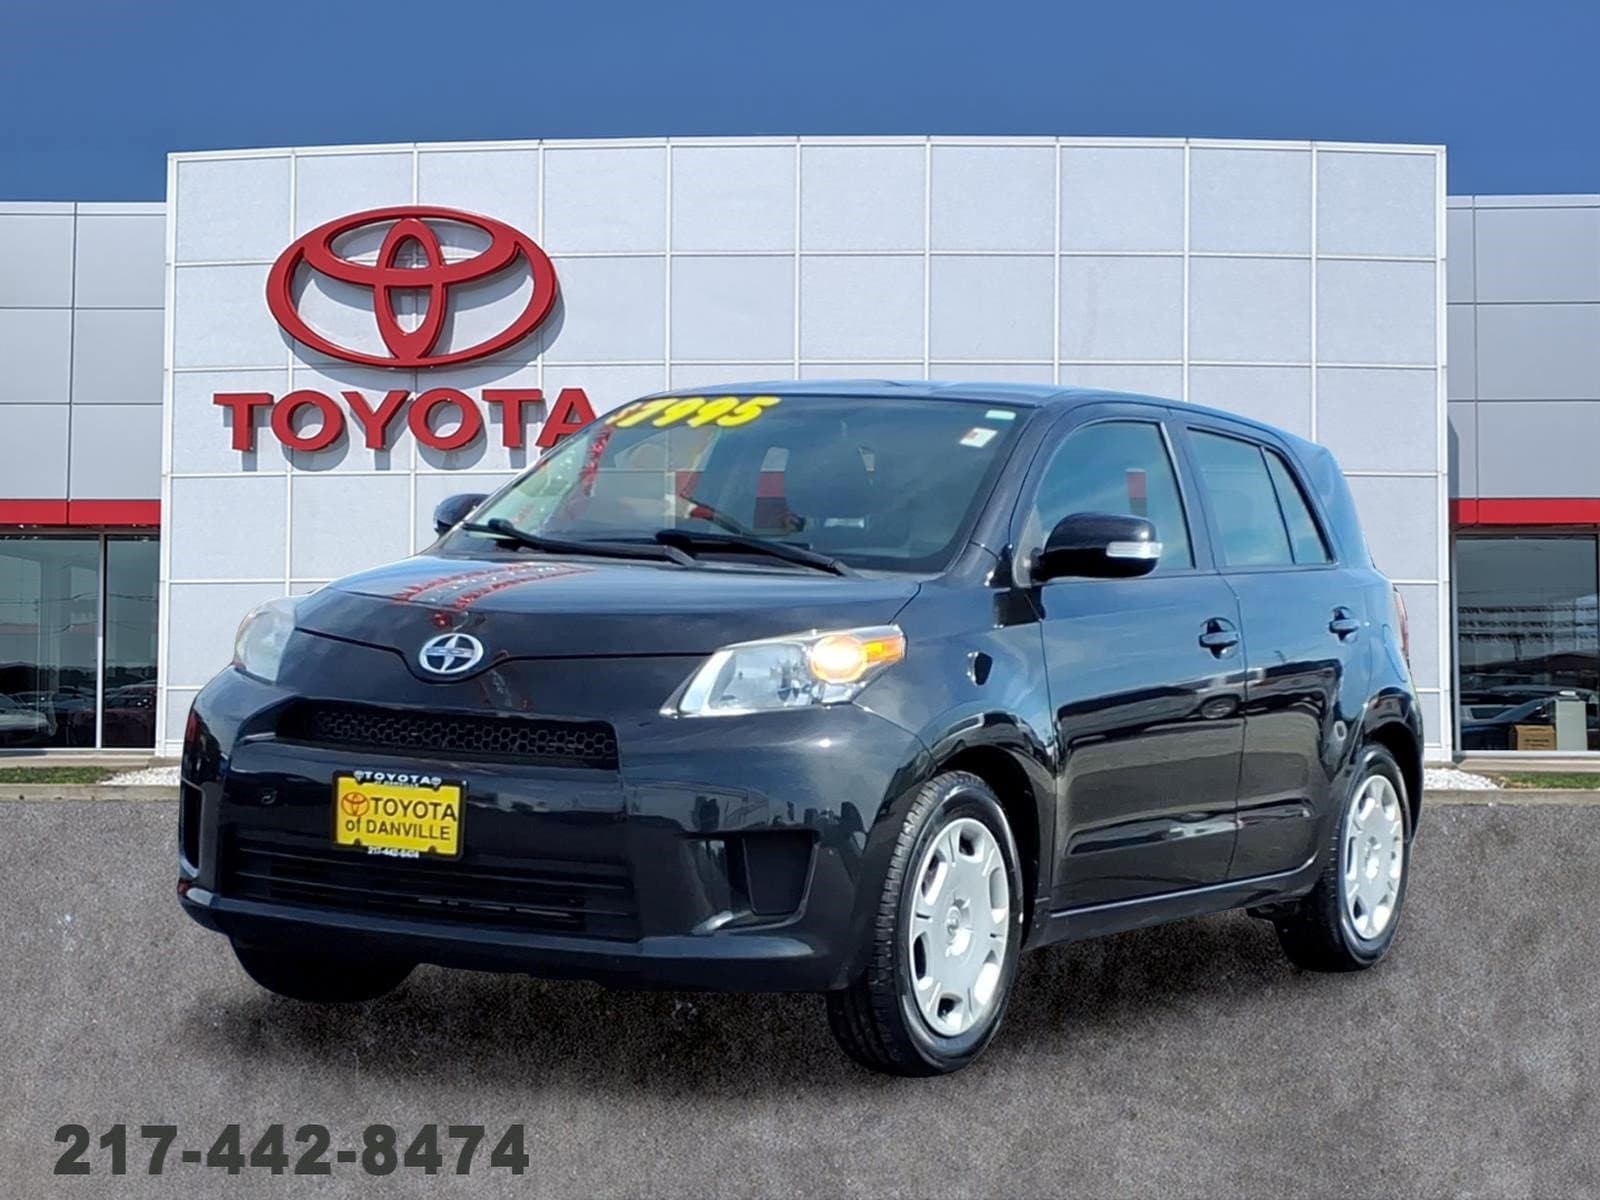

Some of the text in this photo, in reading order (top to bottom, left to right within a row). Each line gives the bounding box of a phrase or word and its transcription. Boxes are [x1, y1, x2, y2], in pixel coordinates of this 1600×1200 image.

[213, 388, 597, 452] TOYOTA
[364, 771, 431, 785] TOYOTA
[370, 797, 458, 822] TOYOTA
[345, 815, 451, 841] of DANVILLE
